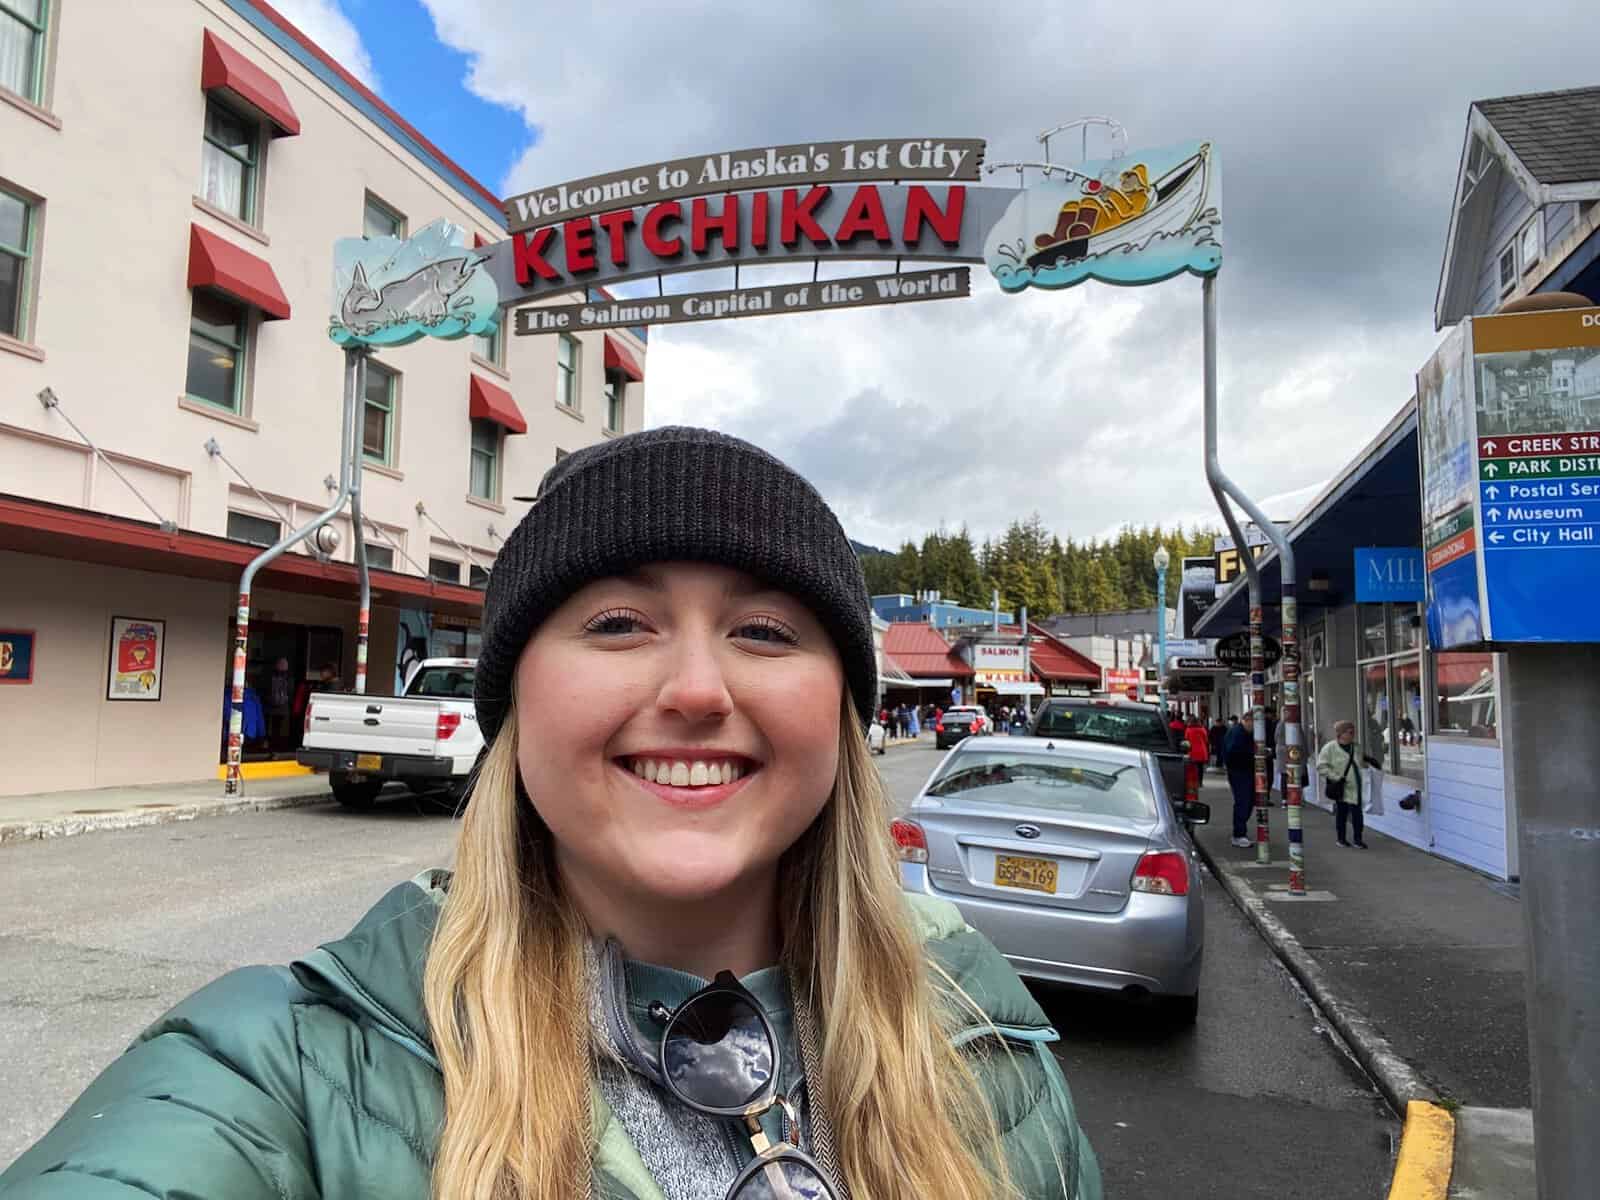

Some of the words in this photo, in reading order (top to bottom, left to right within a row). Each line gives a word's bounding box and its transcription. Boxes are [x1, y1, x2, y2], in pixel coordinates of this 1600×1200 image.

[515, 174, 649, 222] Welcome
[657, 165, 689, 188] to
[698, 146, 829, 184] Alaska's
[841, 143, 891, 170] 1st
[900, 141, 970, 177] City
[512, 185, 967, 285] KETCHIKAN
[525, 311, 569, 329] The
[580, 304, 671, 325] Salmon
[682, 290, 772, 317] Capital
[784, 287, 809, 306] of
[821, 283, 863, 304] the
[876, 272, 957, 298] World
[1508, 438, 1562, 453] CREEK
[1570, 437, 1600, 450] STR
[1508, 460, 1551, 474] PARK
[1560, 458, 1600, 472] DIST
[1510, 483, 1563, 498] Postal
[1571, 483, 1600, 496] Ser
[1507, 508, 1583, 520] Museum
[1513, 529, 1550, 544] City
[1559, 527, 1593, 541] Hall
[981, 648, 1019, 656] SALMON
[1033, 869, 1054, 887] 169
